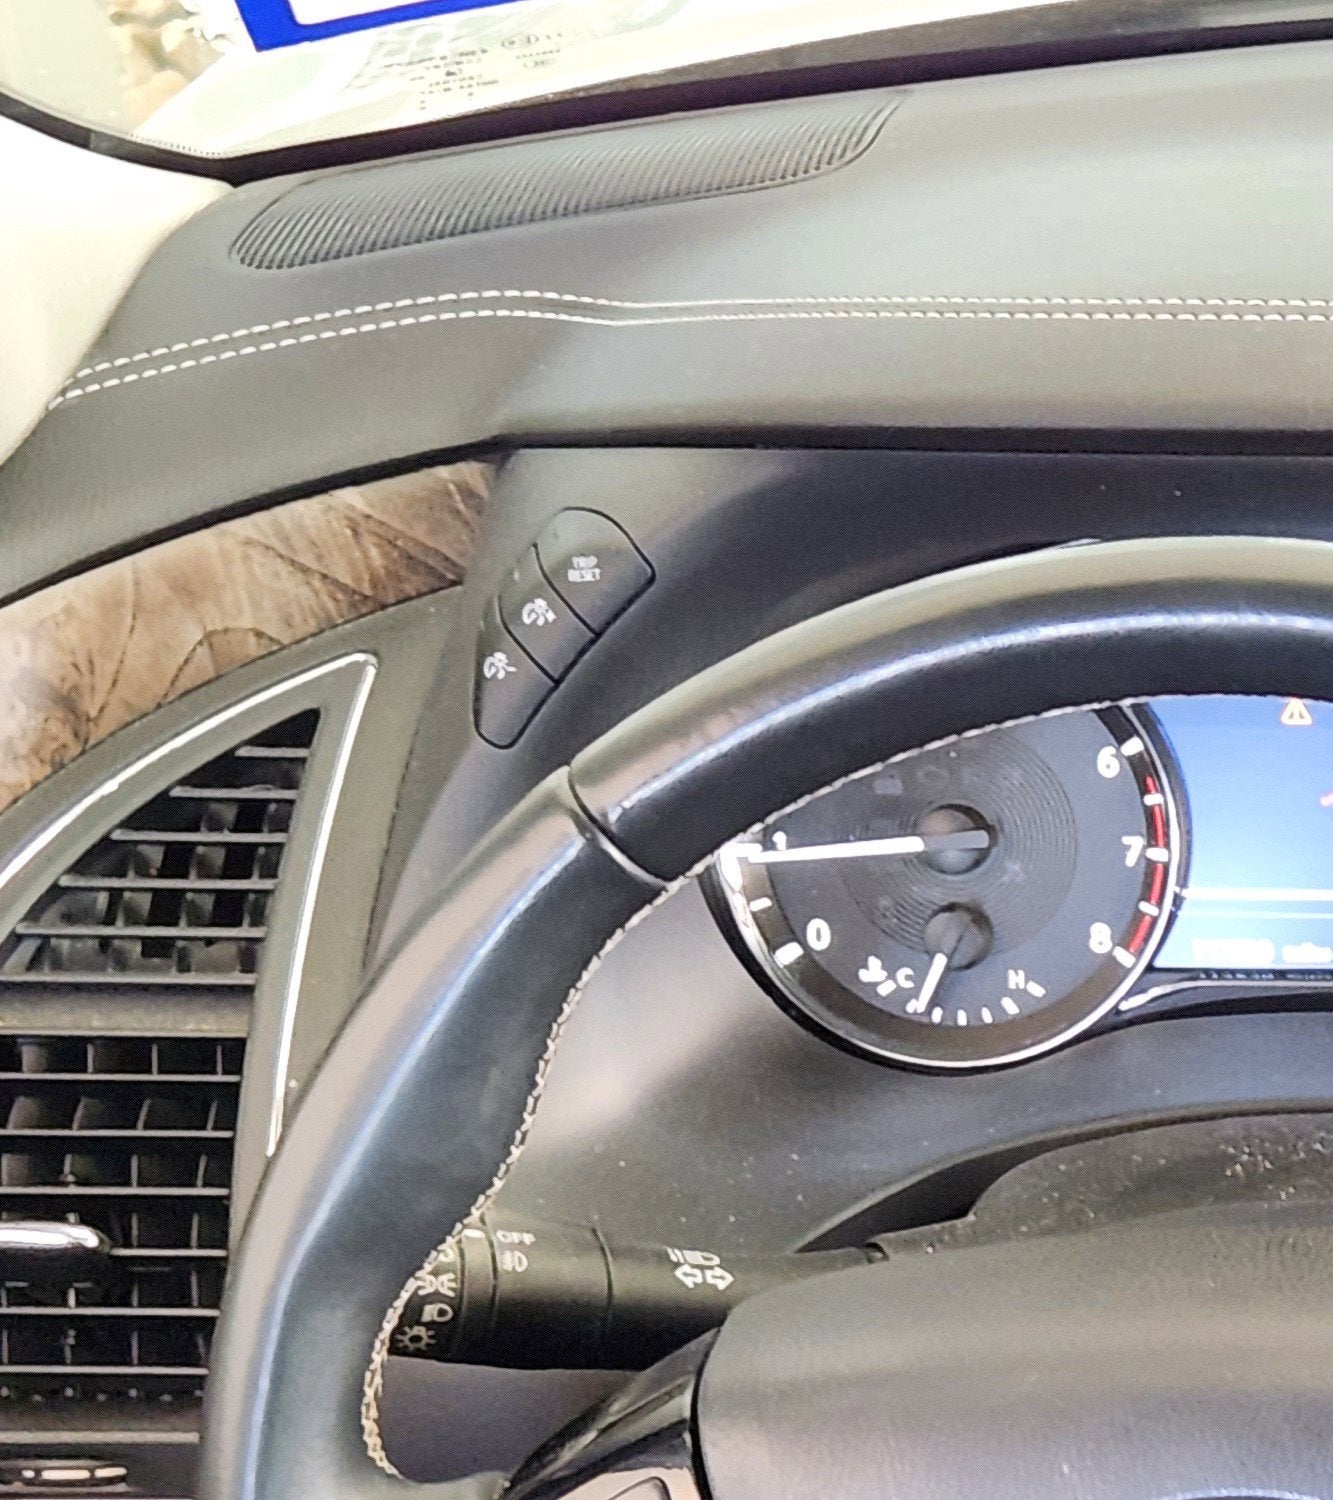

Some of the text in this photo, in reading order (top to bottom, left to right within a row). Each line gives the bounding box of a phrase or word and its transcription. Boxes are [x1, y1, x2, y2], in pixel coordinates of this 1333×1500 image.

[1096, 745, 1121, 779] 6
[771, 830, 788, 850] 1
[1120, 835, 1145, 868] 7
[806, 917, 832, 952] 0
[1088, 921, 1113, 954] 8
[895, 966, 915, 989] C
[1007, 969, 1026, 990] H
